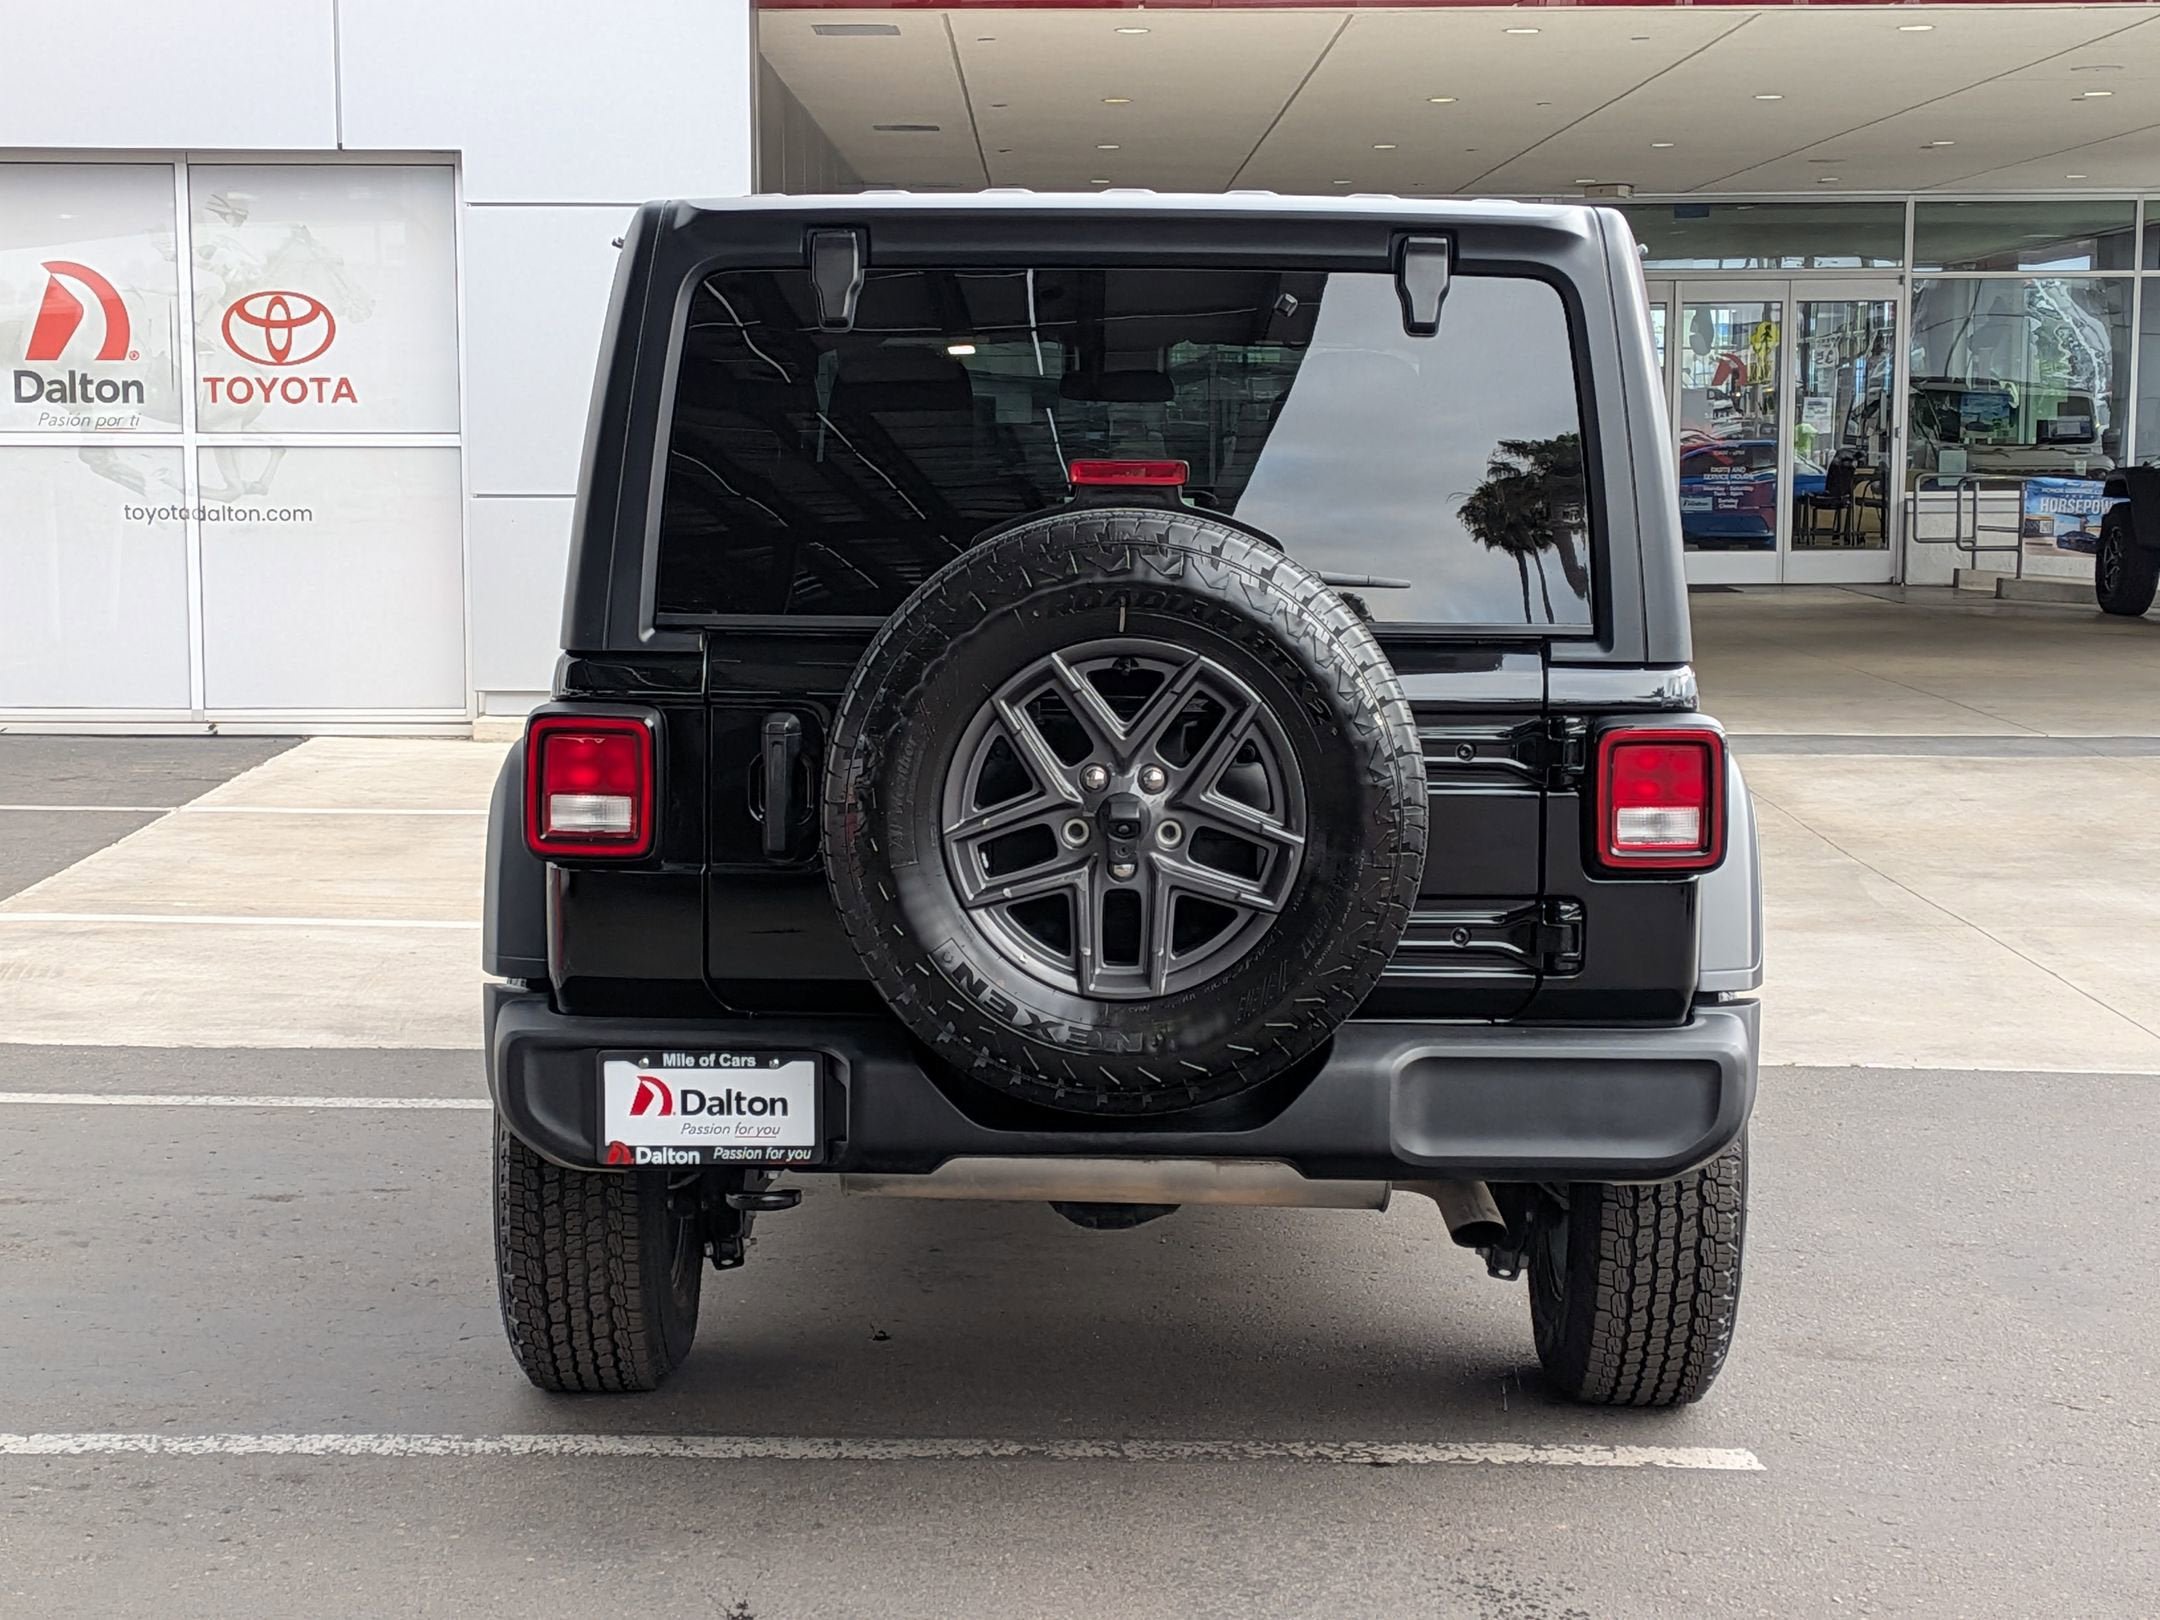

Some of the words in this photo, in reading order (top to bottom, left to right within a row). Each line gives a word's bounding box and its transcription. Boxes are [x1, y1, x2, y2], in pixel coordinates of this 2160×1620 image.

[13, 369, 145, 404] Dalton
[203, 376, 357, 404] TOYOTA
[38, 411, 90, 428] Pasión
[95, 413, 125, 431] por
[129, 412, 142, 427] ti
[124, 503, 313, 524] toyotadalton.com
[947, 959, 1142, 1054] NEXEN
[662, 1053, 694, 1067] Mile
[699, 1053, 715, 1067] of
[719, 1054, 756, 1067] Cars
[680, 1088, 788, 1117] Dalton
[680, 1123, 730, 1135] Passion
[735, 1122, 753, 1135] for
[756, 1126, 780, 1137] you
[635, 1147, 700, 1165] Dalton
[713, 1148, 762, 1160] Passion
[764, 1148, 785, 1161] for
[787, 1151, 812, 1163] you
